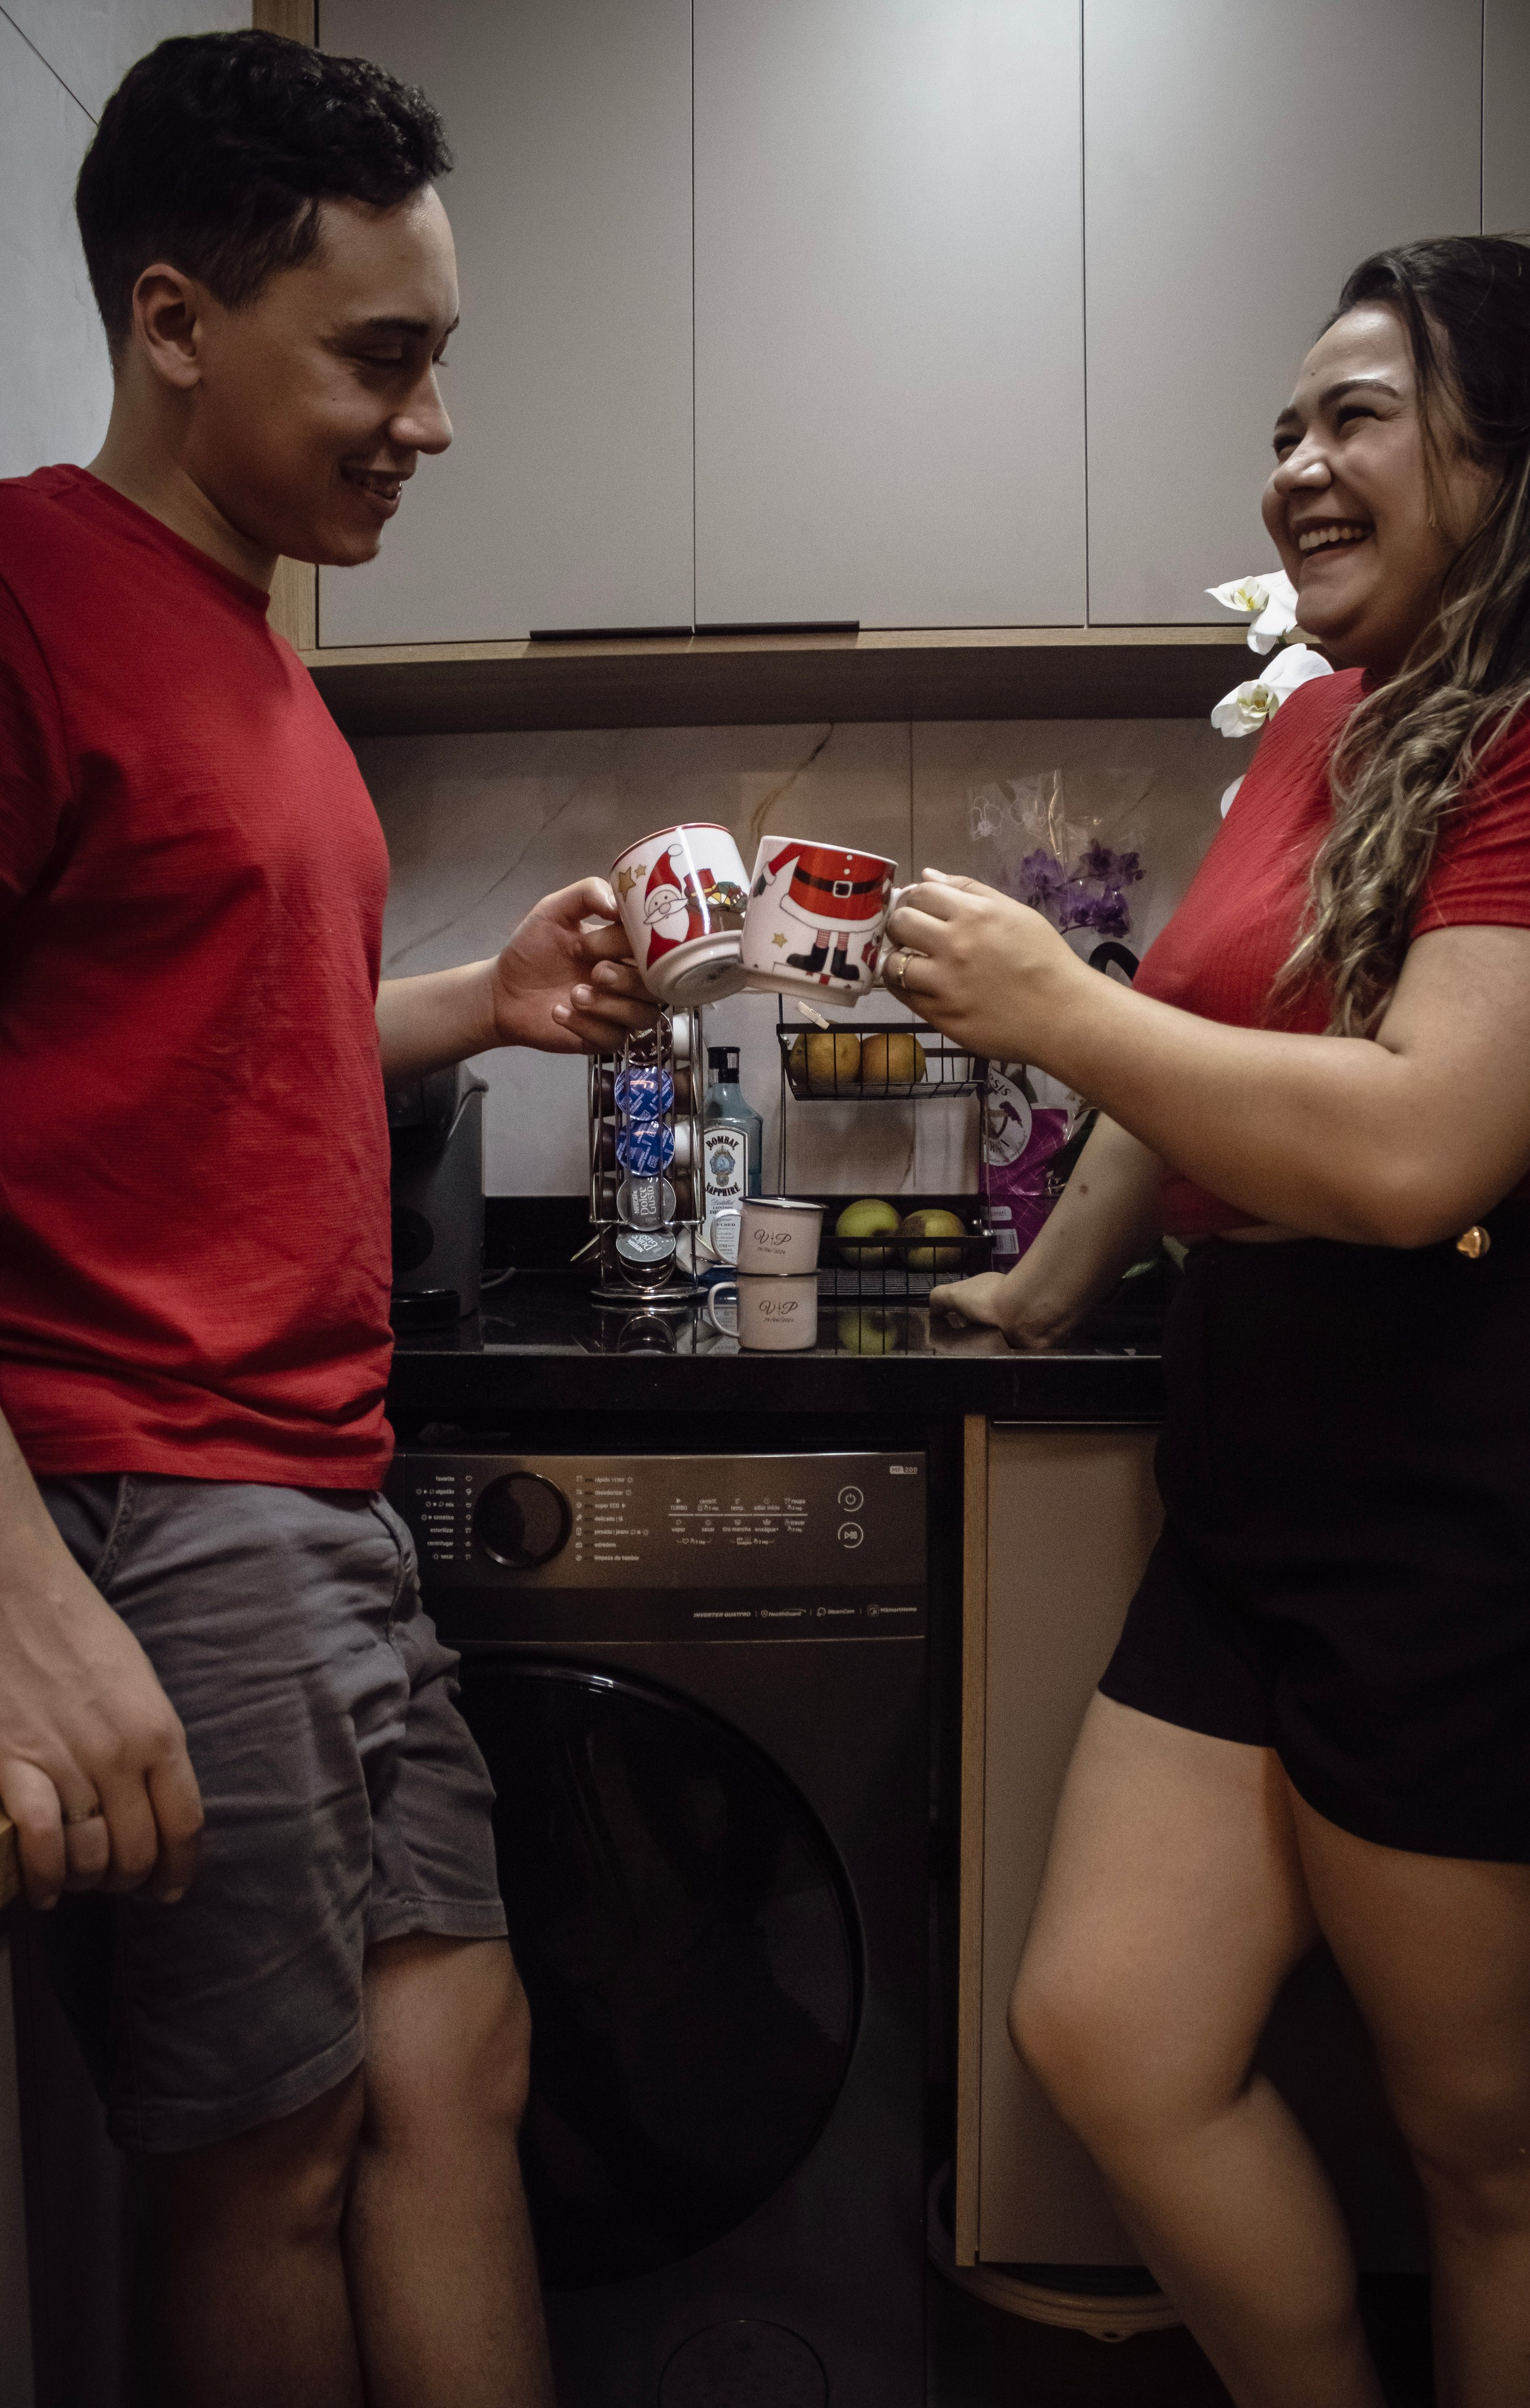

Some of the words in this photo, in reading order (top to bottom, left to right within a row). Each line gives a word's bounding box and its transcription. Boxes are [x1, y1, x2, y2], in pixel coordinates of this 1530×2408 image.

[706, 1136, 739, 1150] BOMBAY
[705, 1182, 740, 1196] SAPPHIRE
[639, 1187, 649, 1216] Dolce
[645, 1185, 656, 1214] Gusto
[631, 1234, 653, 1251] Dolce
